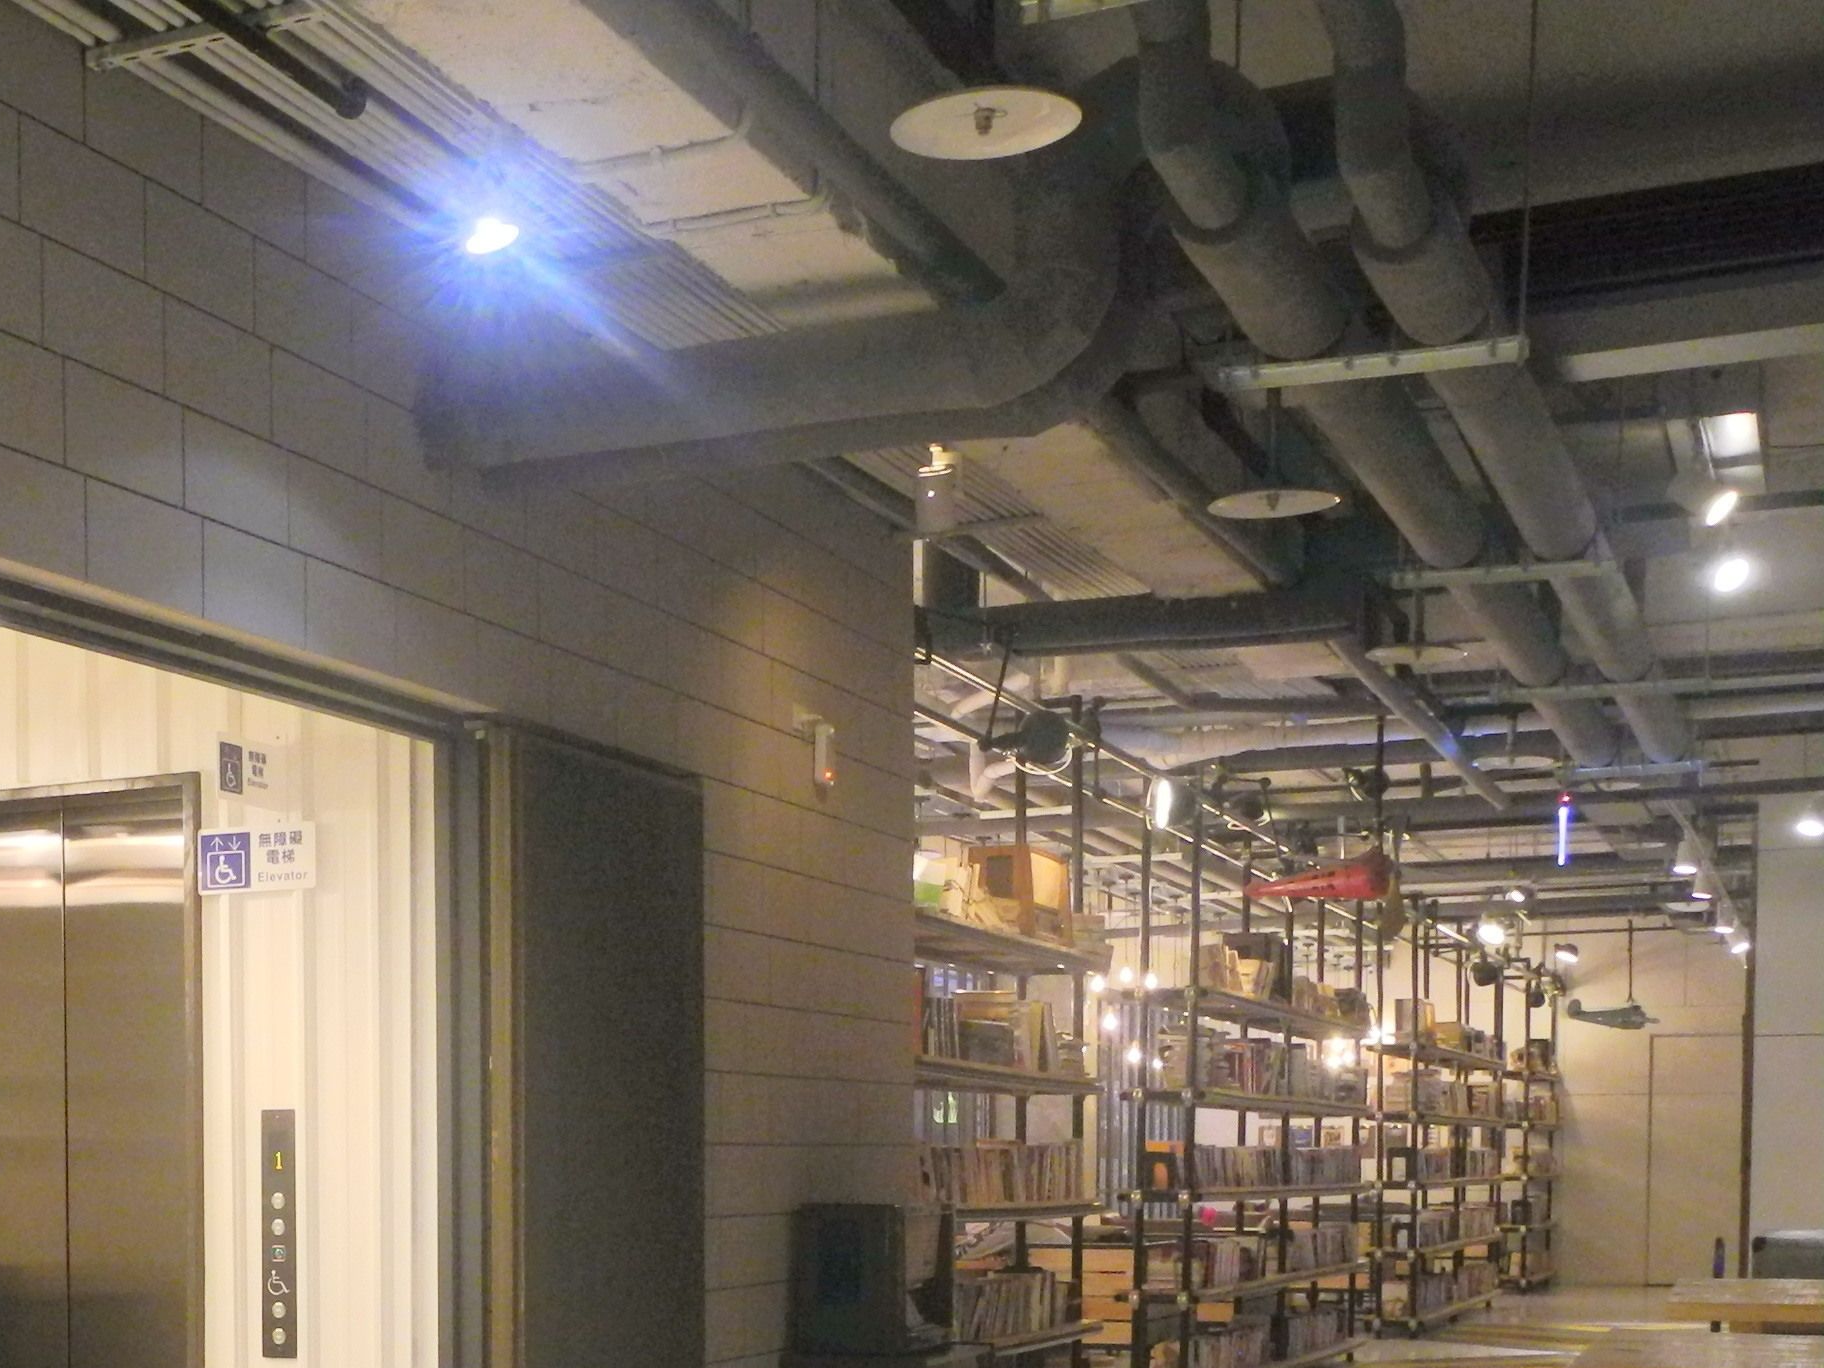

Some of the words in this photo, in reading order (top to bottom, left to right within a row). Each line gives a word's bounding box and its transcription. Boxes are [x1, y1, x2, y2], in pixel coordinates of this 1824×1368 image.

[258, 830, 303, 848] 無障礙
[266, 849, 295, 865] 電梯
[257, 870, 308, 883] Elevator
[275, 1151, 283, 1170] 1
